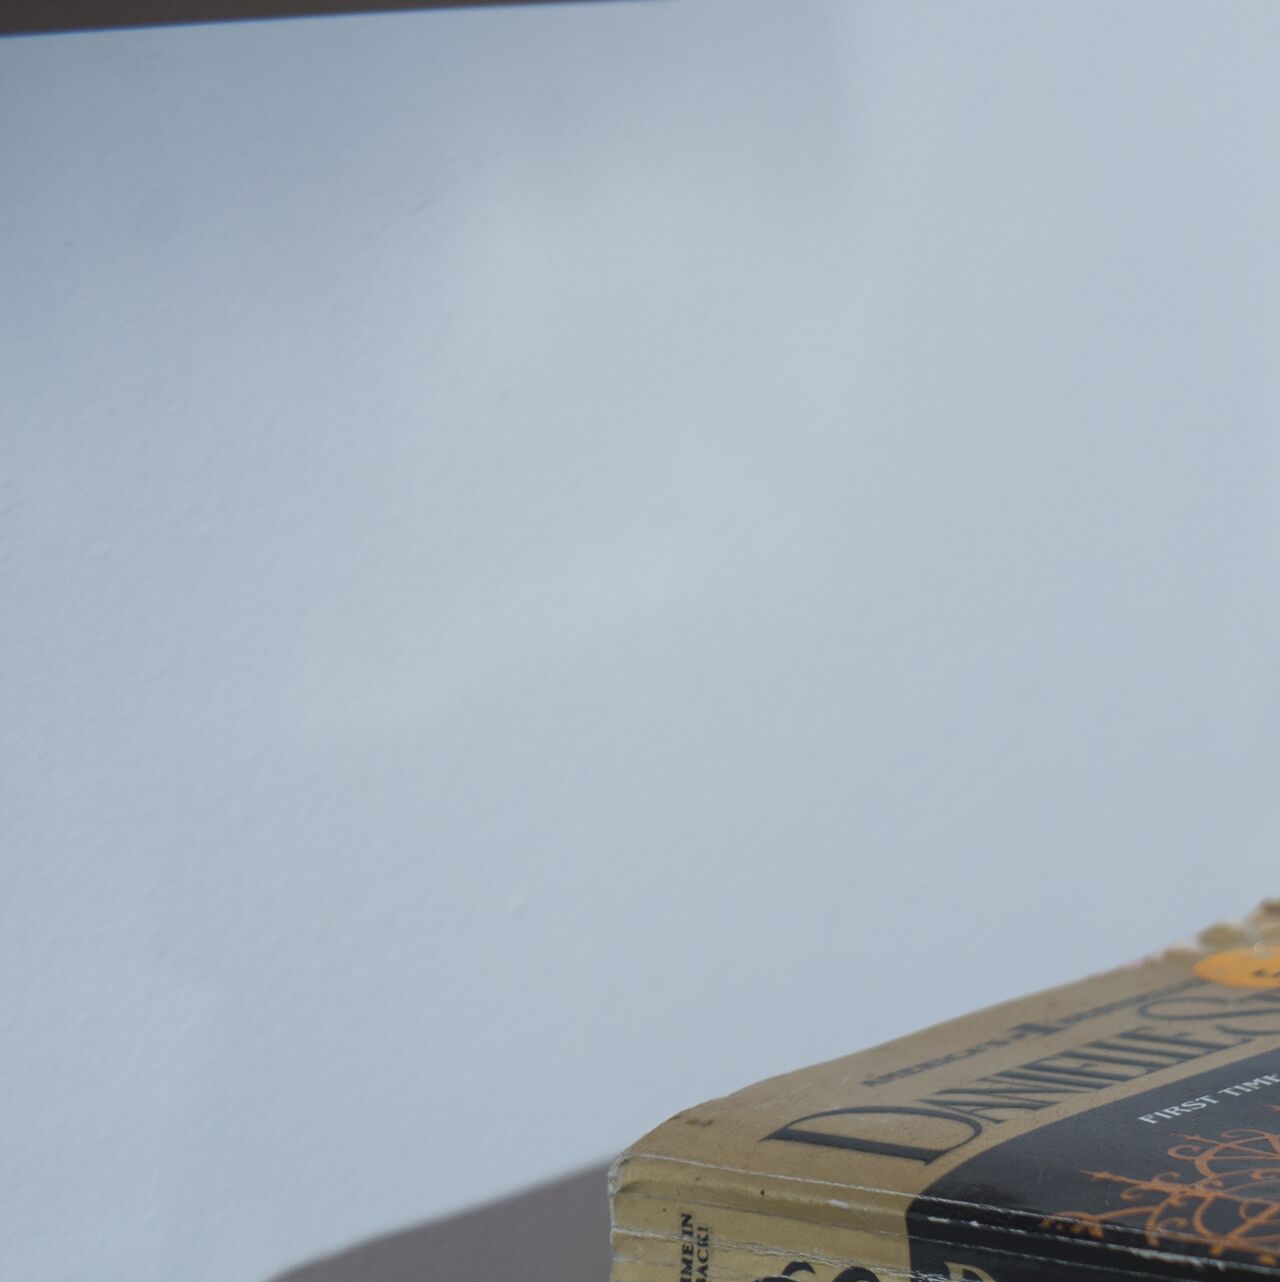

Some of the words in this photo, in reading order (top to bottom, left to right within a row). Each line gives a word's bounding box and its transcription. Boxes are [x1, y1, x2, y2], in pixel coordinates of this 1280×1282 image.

[761, 1025, 1255, 1166] DANIELLE
[1137, 1094, 1220, 1125] FIRST
[681, 1212, 694, 1237] IN
